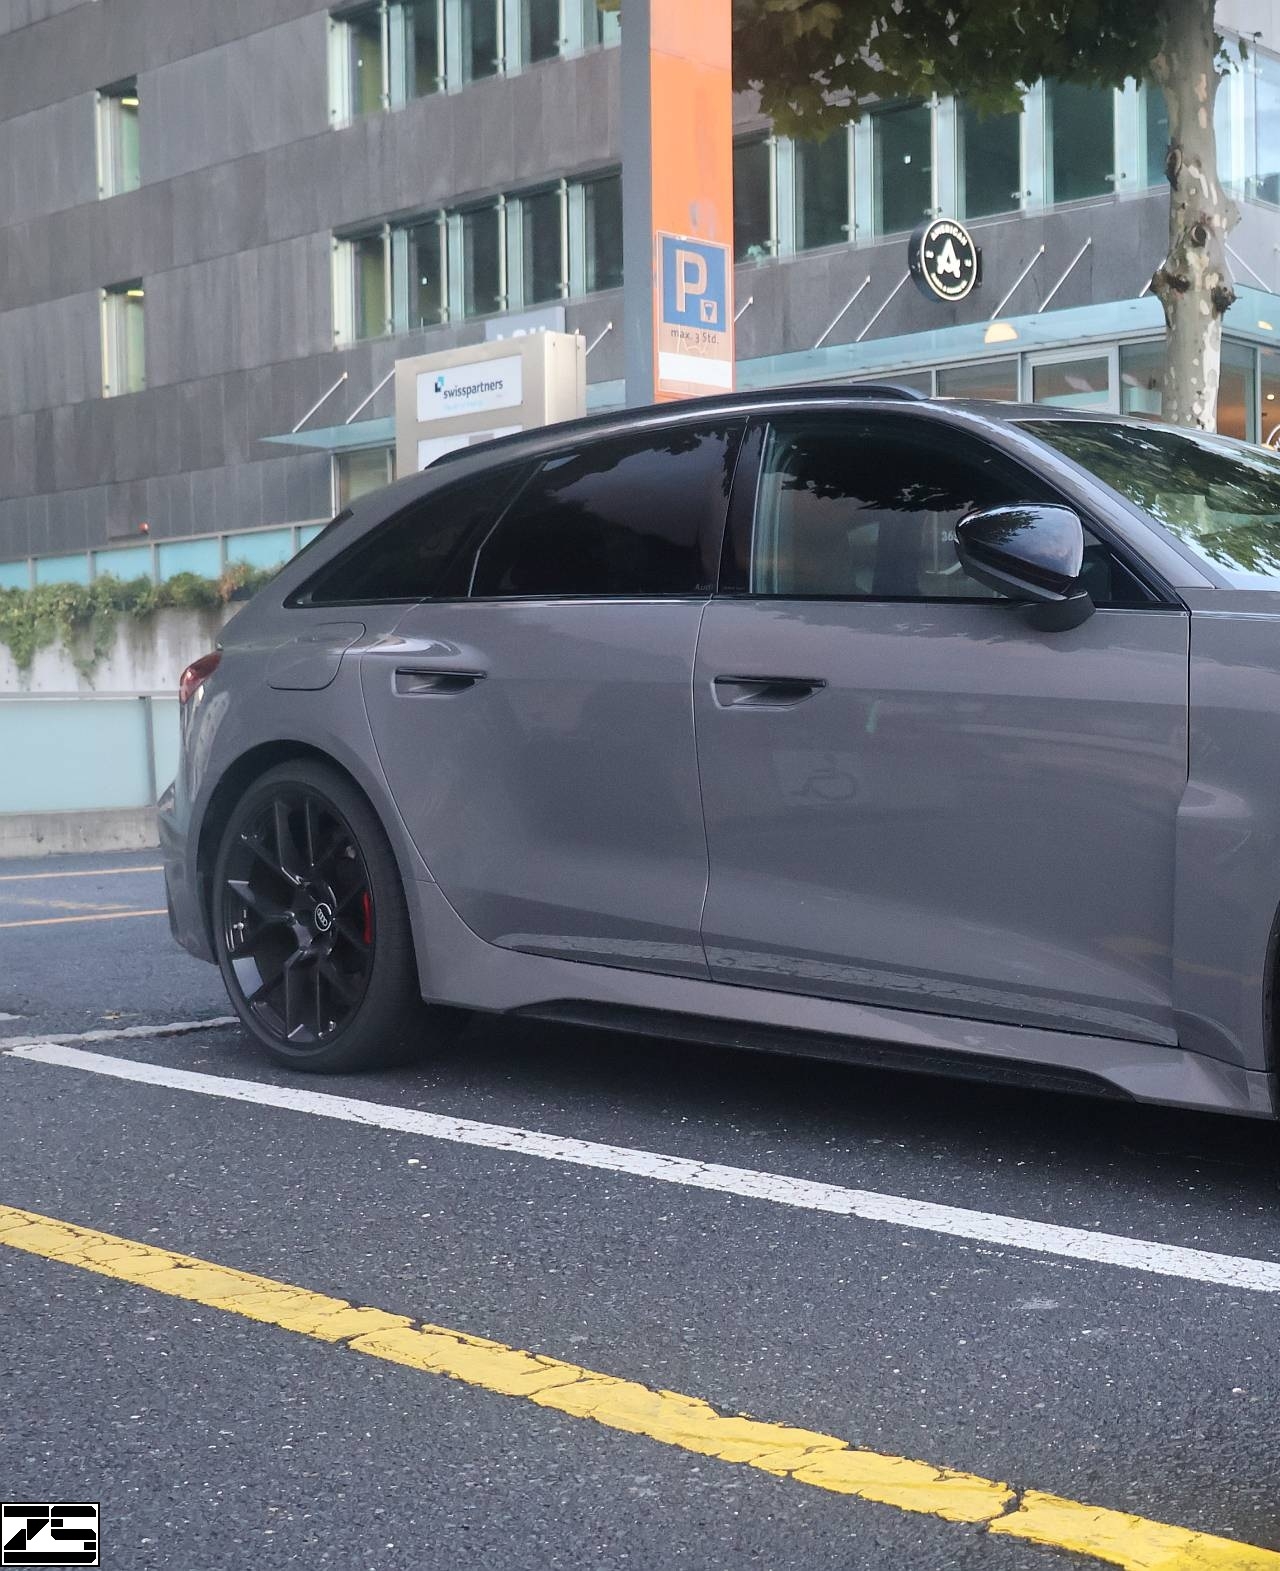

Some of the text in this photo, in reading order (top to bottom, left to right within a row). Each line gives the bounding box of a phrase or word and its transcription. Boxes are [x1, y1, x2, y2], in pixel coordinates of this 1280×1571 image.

[930, 224, 968, 247] AMERICAN
[676, 250, 708, 313] P
[670, 328, 693, 341] max.
[702, 331, 719, 345] Std.
[443, 379, 504, 400] swisspartners
